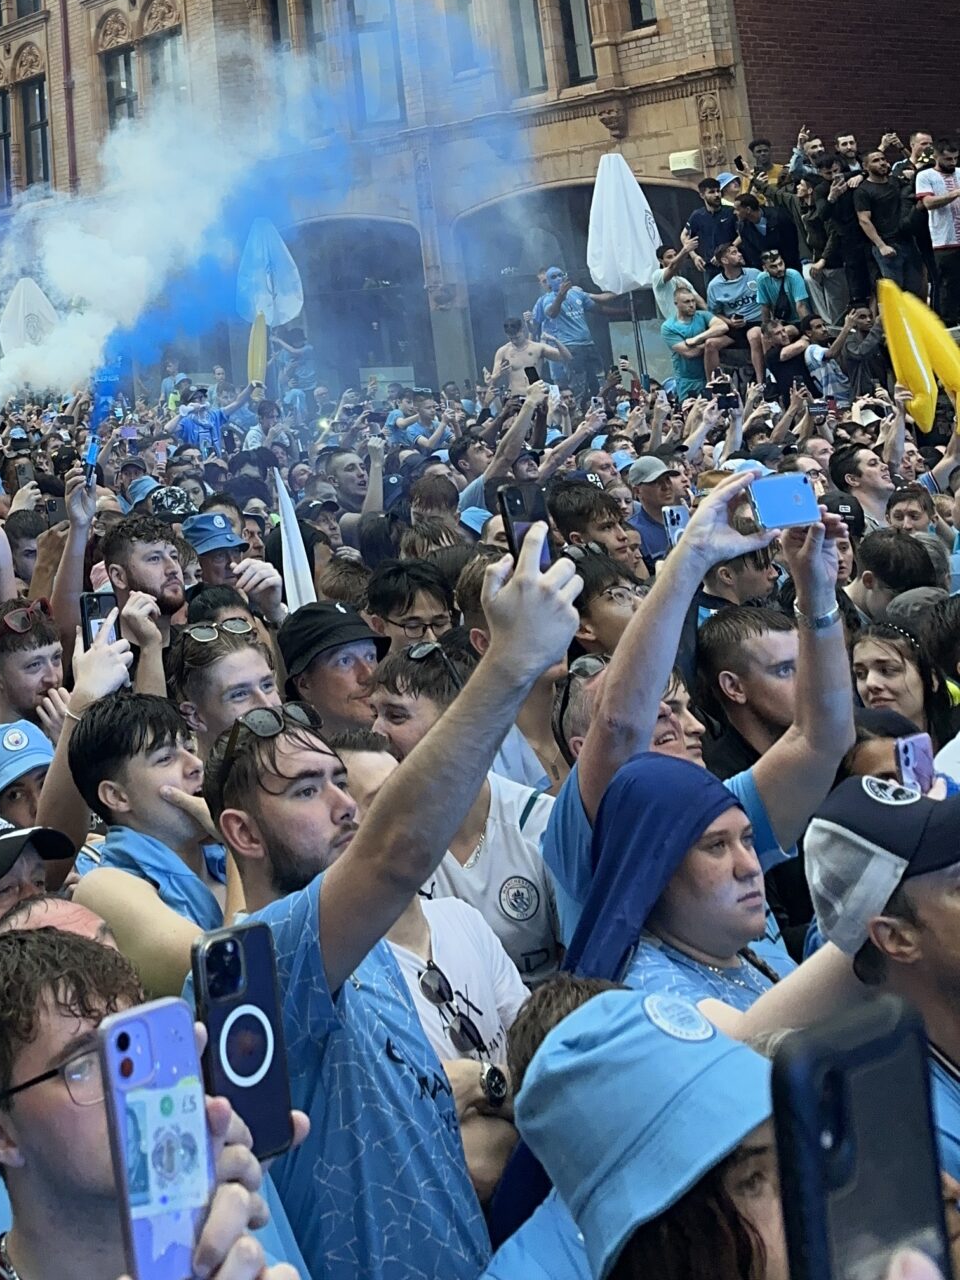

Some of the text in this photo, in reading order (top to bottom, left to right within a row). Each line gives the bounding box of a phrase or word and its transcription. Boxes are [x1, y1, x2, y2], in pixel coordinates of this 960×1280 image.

[728, 295, 757, 309] brothe
[503, 880, 534, 895] MANCHESTER
[181, 1095, 197, 1114] £5
